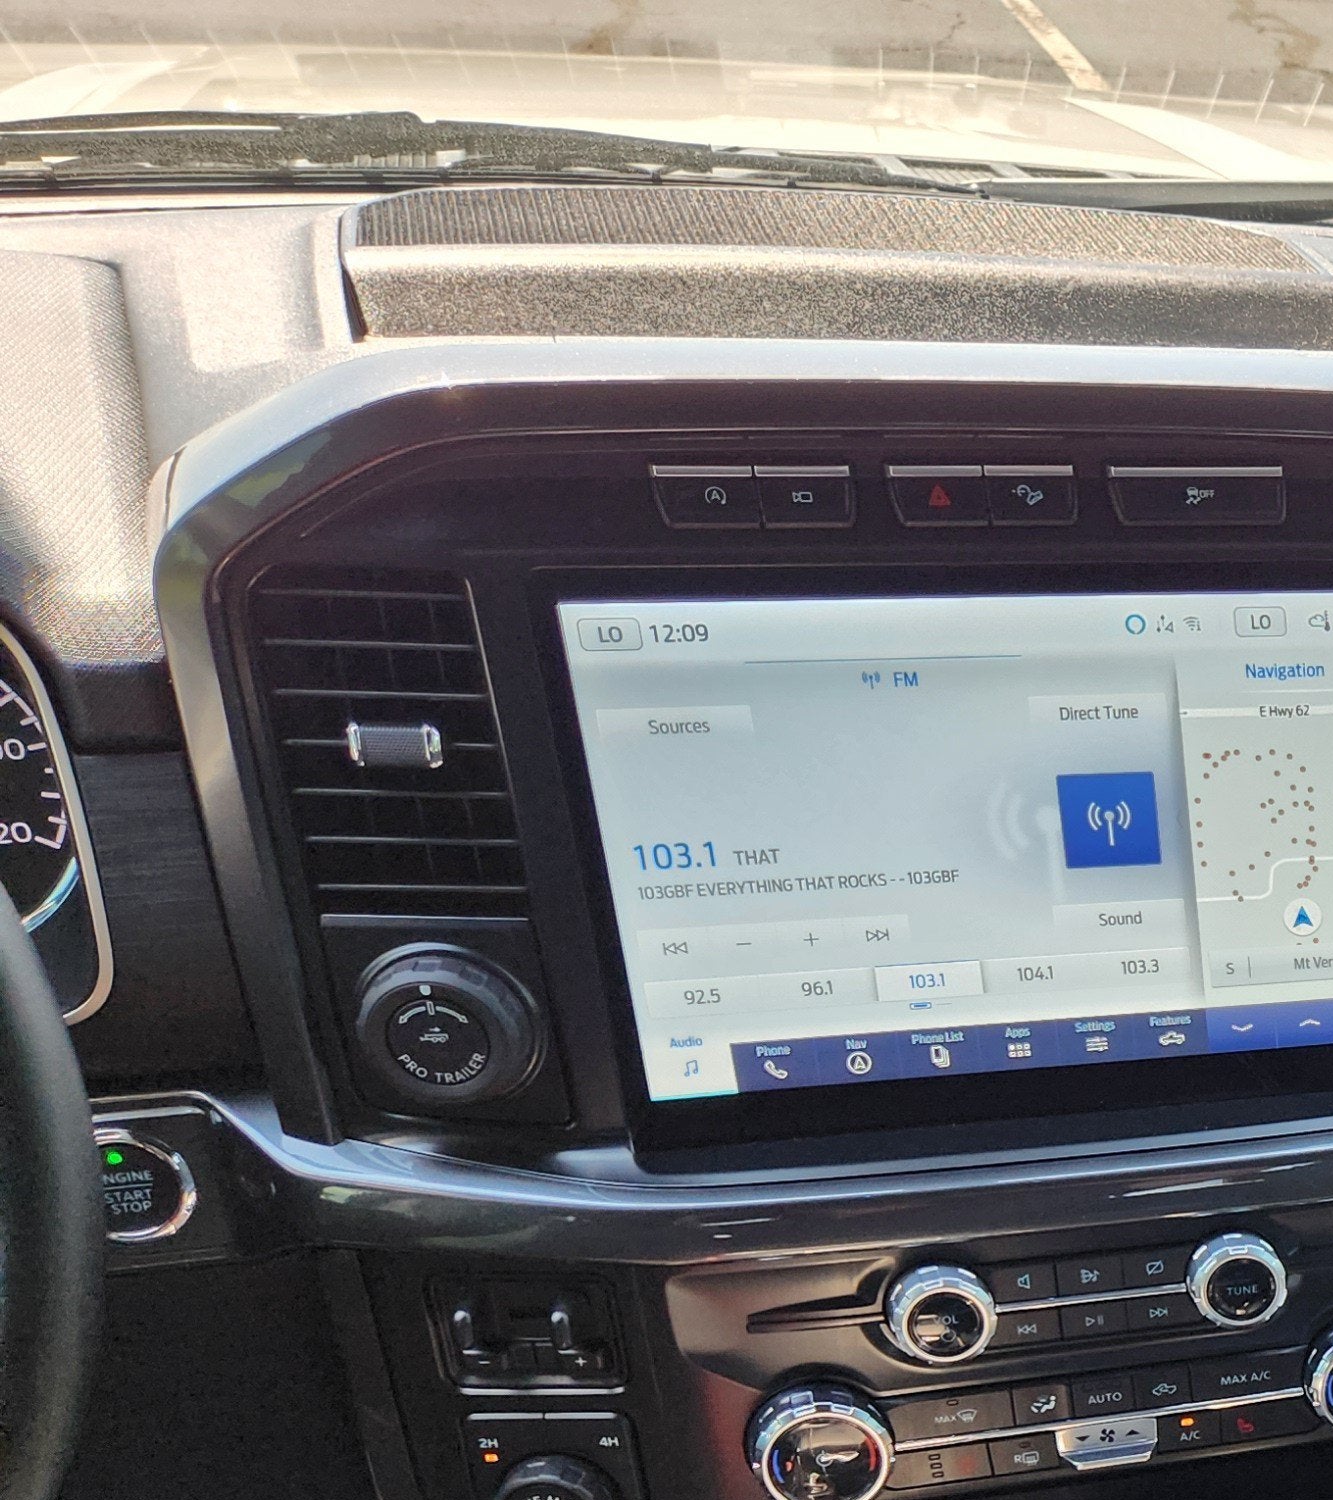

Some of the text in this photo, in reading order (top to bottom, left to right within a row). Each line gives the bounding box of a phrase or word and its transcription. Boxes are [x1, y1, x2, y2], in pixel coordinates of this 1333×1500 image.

[1199, 489, 1215, 499] OFF
[1250, 614, 1271, 631] LO
[598, 625, 623, 643] LO
[648, 623, 709, 643] 12:09
[893, 671, 919, 687] FM
[1245, 662, 1325, 681] Navigation
[1059, 705, 1139, 721] Direct Tune
[1259, 704, 1310, 720] E Hwy 62
[648, 718, 710, 736] Sources
[0, 738, 26, 762] 0
[633, 841, 717, 871] 103.1
[733, 848, 780, 866] THAT
[638, 882, 695, 901] 103GBF
[696, 877, 793, 897] EVERYTHING
[795, 876, 836, 892] THAT
[838, 872, 888, 889] ROCKS
[907, 869, 960, 886] 103GBF
[1099, 911, 1143, 927] Sound
[1226, 962, 1235, 975] S
[1294, 957, 1311, 970] Mt
[684, 959, 1160, 1005] 92.5 96.1 103.1 104.1 103.3
[1074, 1020, 1116, 1034] Settings
[1149, 1014, 1191, 1028] Features
[911, 1031, 965, 1045] Phone List
[1005, 1027, 1031, 1039] Apps
[670, 1035, 703, 1048] Audio
[845, 1038, 867, 1050] Nav
[755, 1043, 791, 1057] Phone
[398, 1052, 486, 1083] PRO TRAILER
[103, 1170, 154, 1185] NGINE
[104, 1188, 152, 1204] START
[110, 1201, 152, 1216] STOP
[1226, 1283, 1259, 1296] TUNE
[1220, 1370, 1272, 1386] MAX A/C
[1088, 1391, 1123, 1406] AUTO
[934, 1414, 958, 1425] MAX
[478, 1436, 619, 1449] 2H 4H
[1180, 1429, 1201, 1441] A/C
